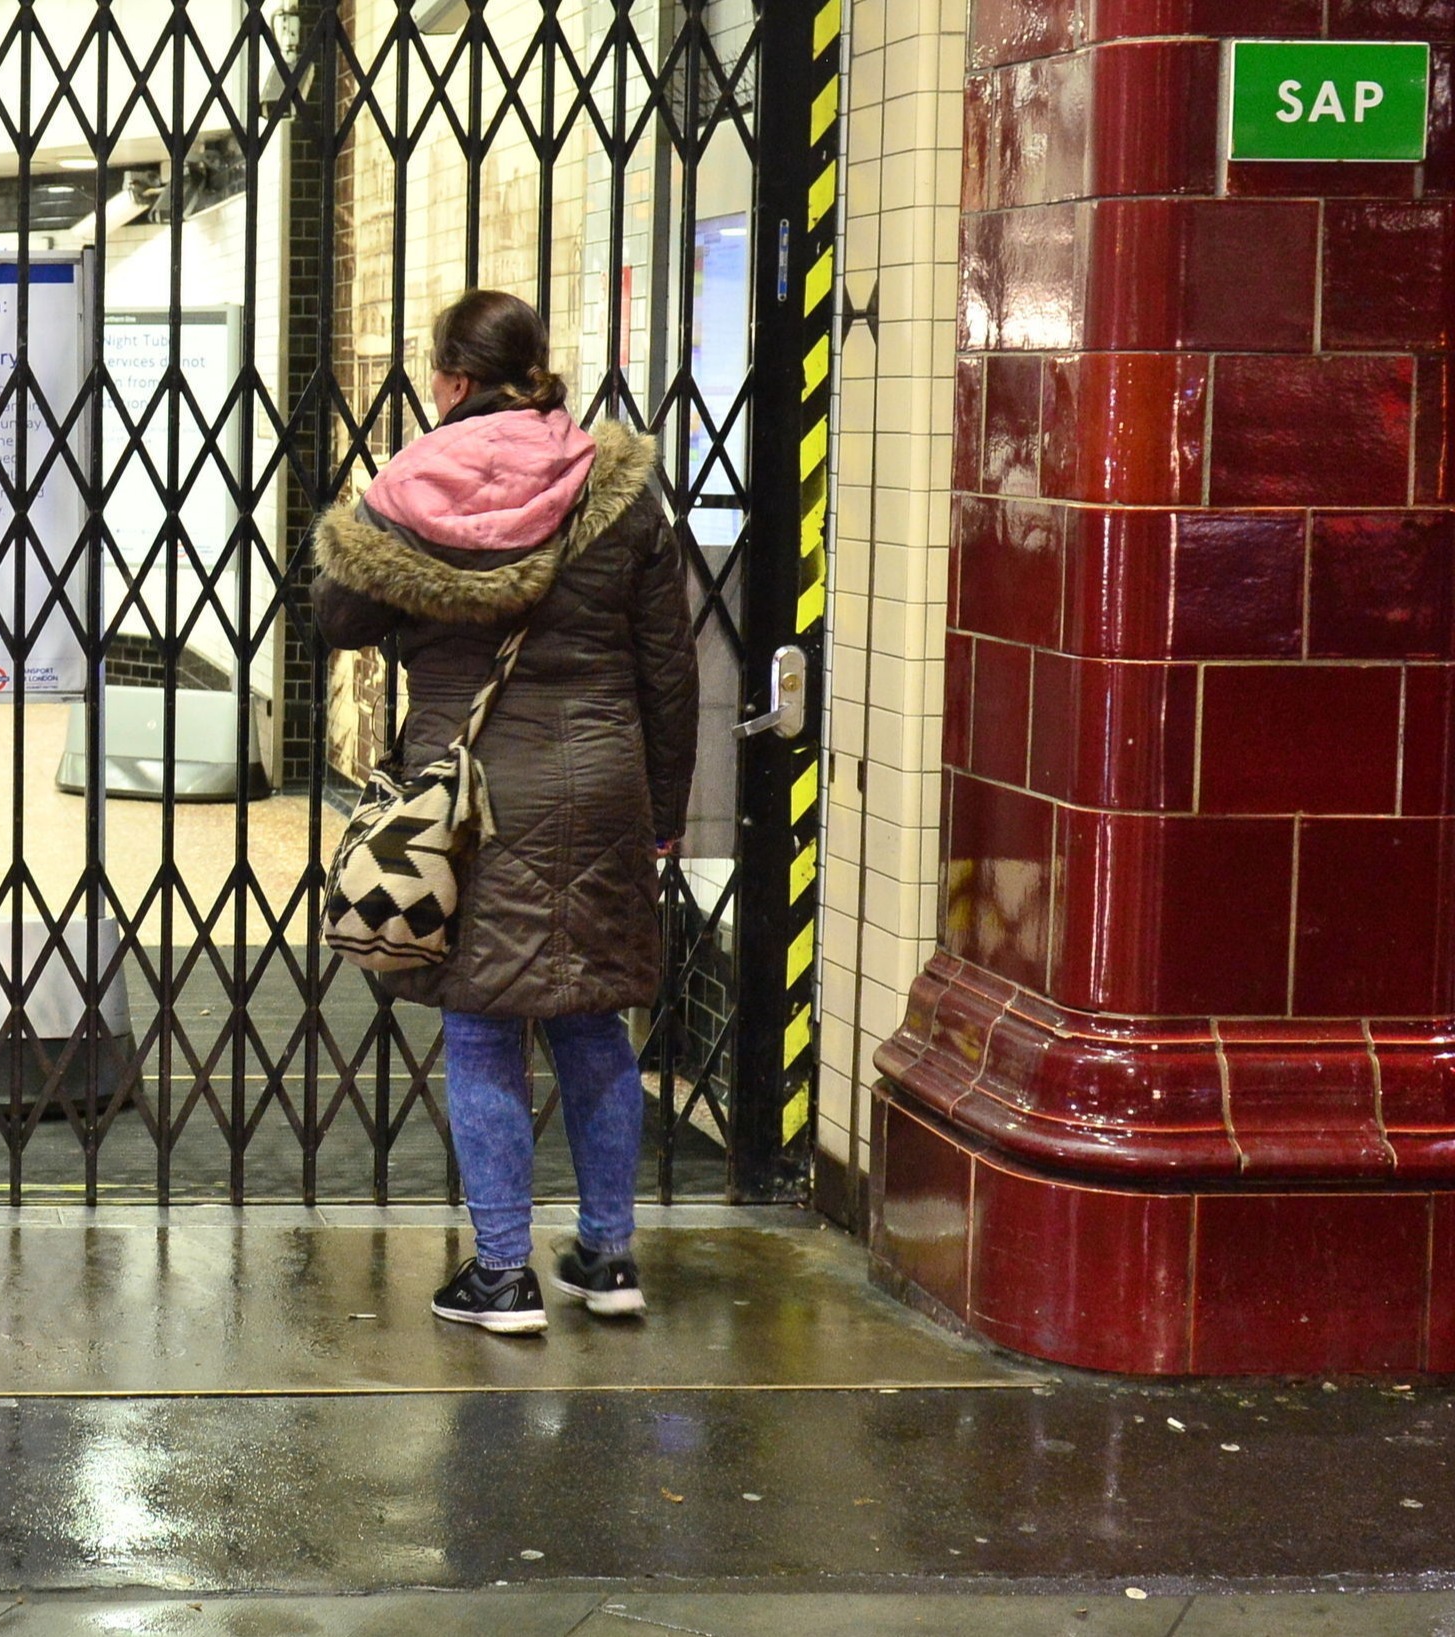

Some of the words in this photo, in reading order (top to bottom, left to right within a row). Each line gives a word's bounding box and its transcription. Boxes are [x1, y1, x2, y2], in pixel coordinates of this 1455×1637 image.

[1275, 79, 1385, 123] SAP
[143, 333, 170, 347] Tub
[107, 357, 155, 368] ervices
[182, 356, 206, 368] not
